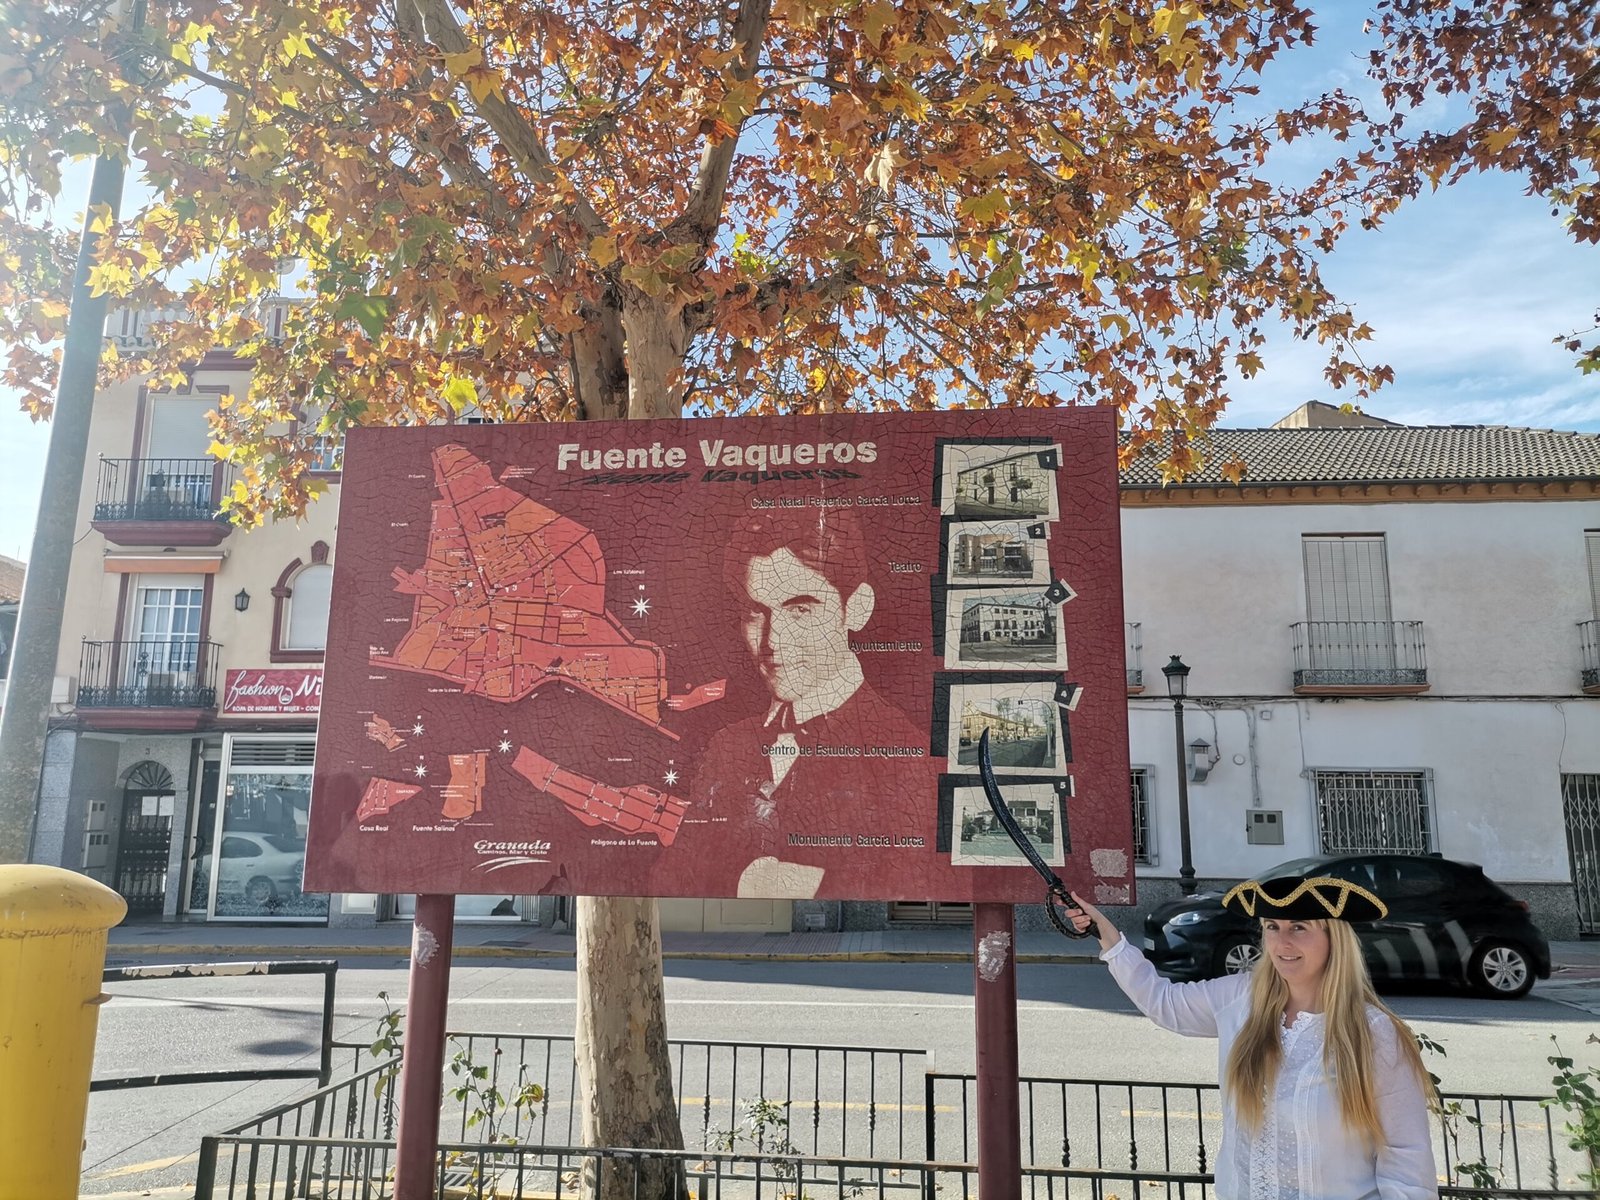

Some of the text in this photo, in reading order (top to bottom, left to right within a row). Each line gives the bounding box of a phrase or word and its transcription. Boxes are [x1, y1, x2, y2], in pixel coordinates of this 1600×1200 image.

[557, 439, 878, 472] Fuente Vaqueros
[1045, 455, 1051, 463] 1
[751, 494, 922, 509] Casa Natal Federico García Lorca
[1034, 527, 1041, 535] 2
[888, 560, 922, 573] Teatro
[1053, 588, 1060, 597] 3
[849, 640, 923, 655] Ayuntamiento
[224, 670, 293, 710] fashion
[1060, 689, 1068, 698] 4
[761, 743, 924, 760] Centro de Estudios Lorquianos
[1060, 781, 1066, 789] 5
[473, 839, 551, 850] Granada
[788, 833, 925, 847] Monumento García Lorca
